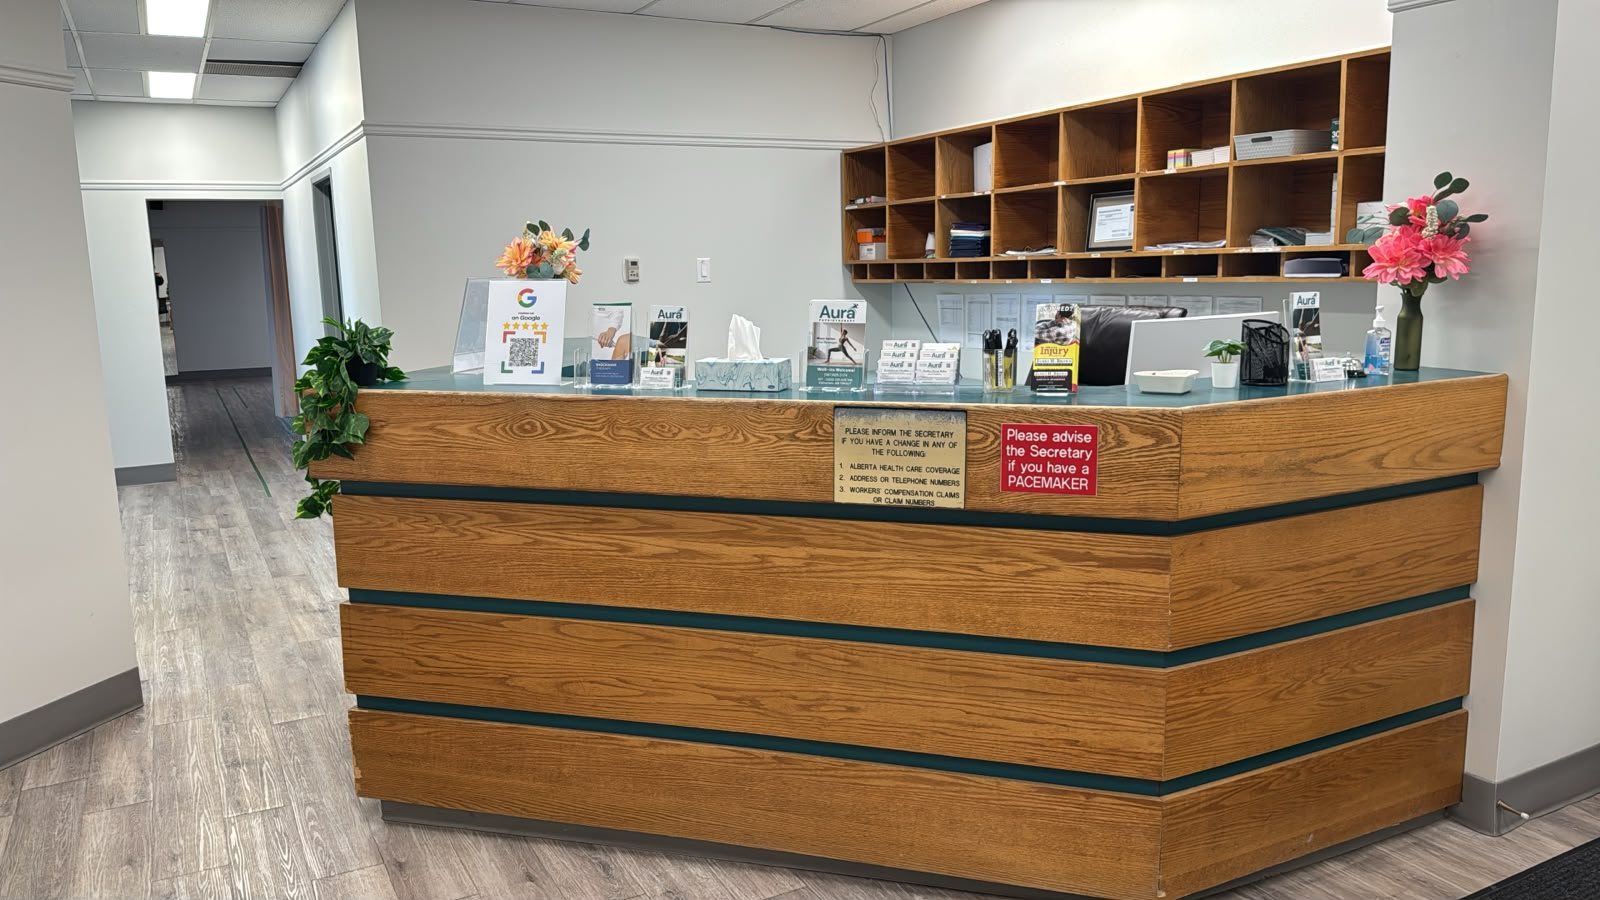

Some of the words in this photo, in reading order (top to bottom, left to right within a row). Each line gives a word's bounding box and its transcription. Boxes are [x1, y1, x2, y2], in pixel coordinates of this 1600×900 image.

[518, 288, 537, 308] G
[658, 308, 682, 319] Aura
[819, 304, 855, 319] Aura
[1040, 347, 1069, 357] Injury
[1007, 429, 1047, 441] Please
[1052, 430, 1092, 443] advise
[1006, 445, 1025, 456] the
[1030, 445, 1092, 461] Secretary
[1008, 460, 1016, 471] if
[1021, 463, 1042, 474] you
[1047, 461, 1076, 473] have
[1082, 466, 1089, 474] a
[1008, 475, 1088, 490] PACEMAKER
[884, 488, 933, 497] COMPENSATION
